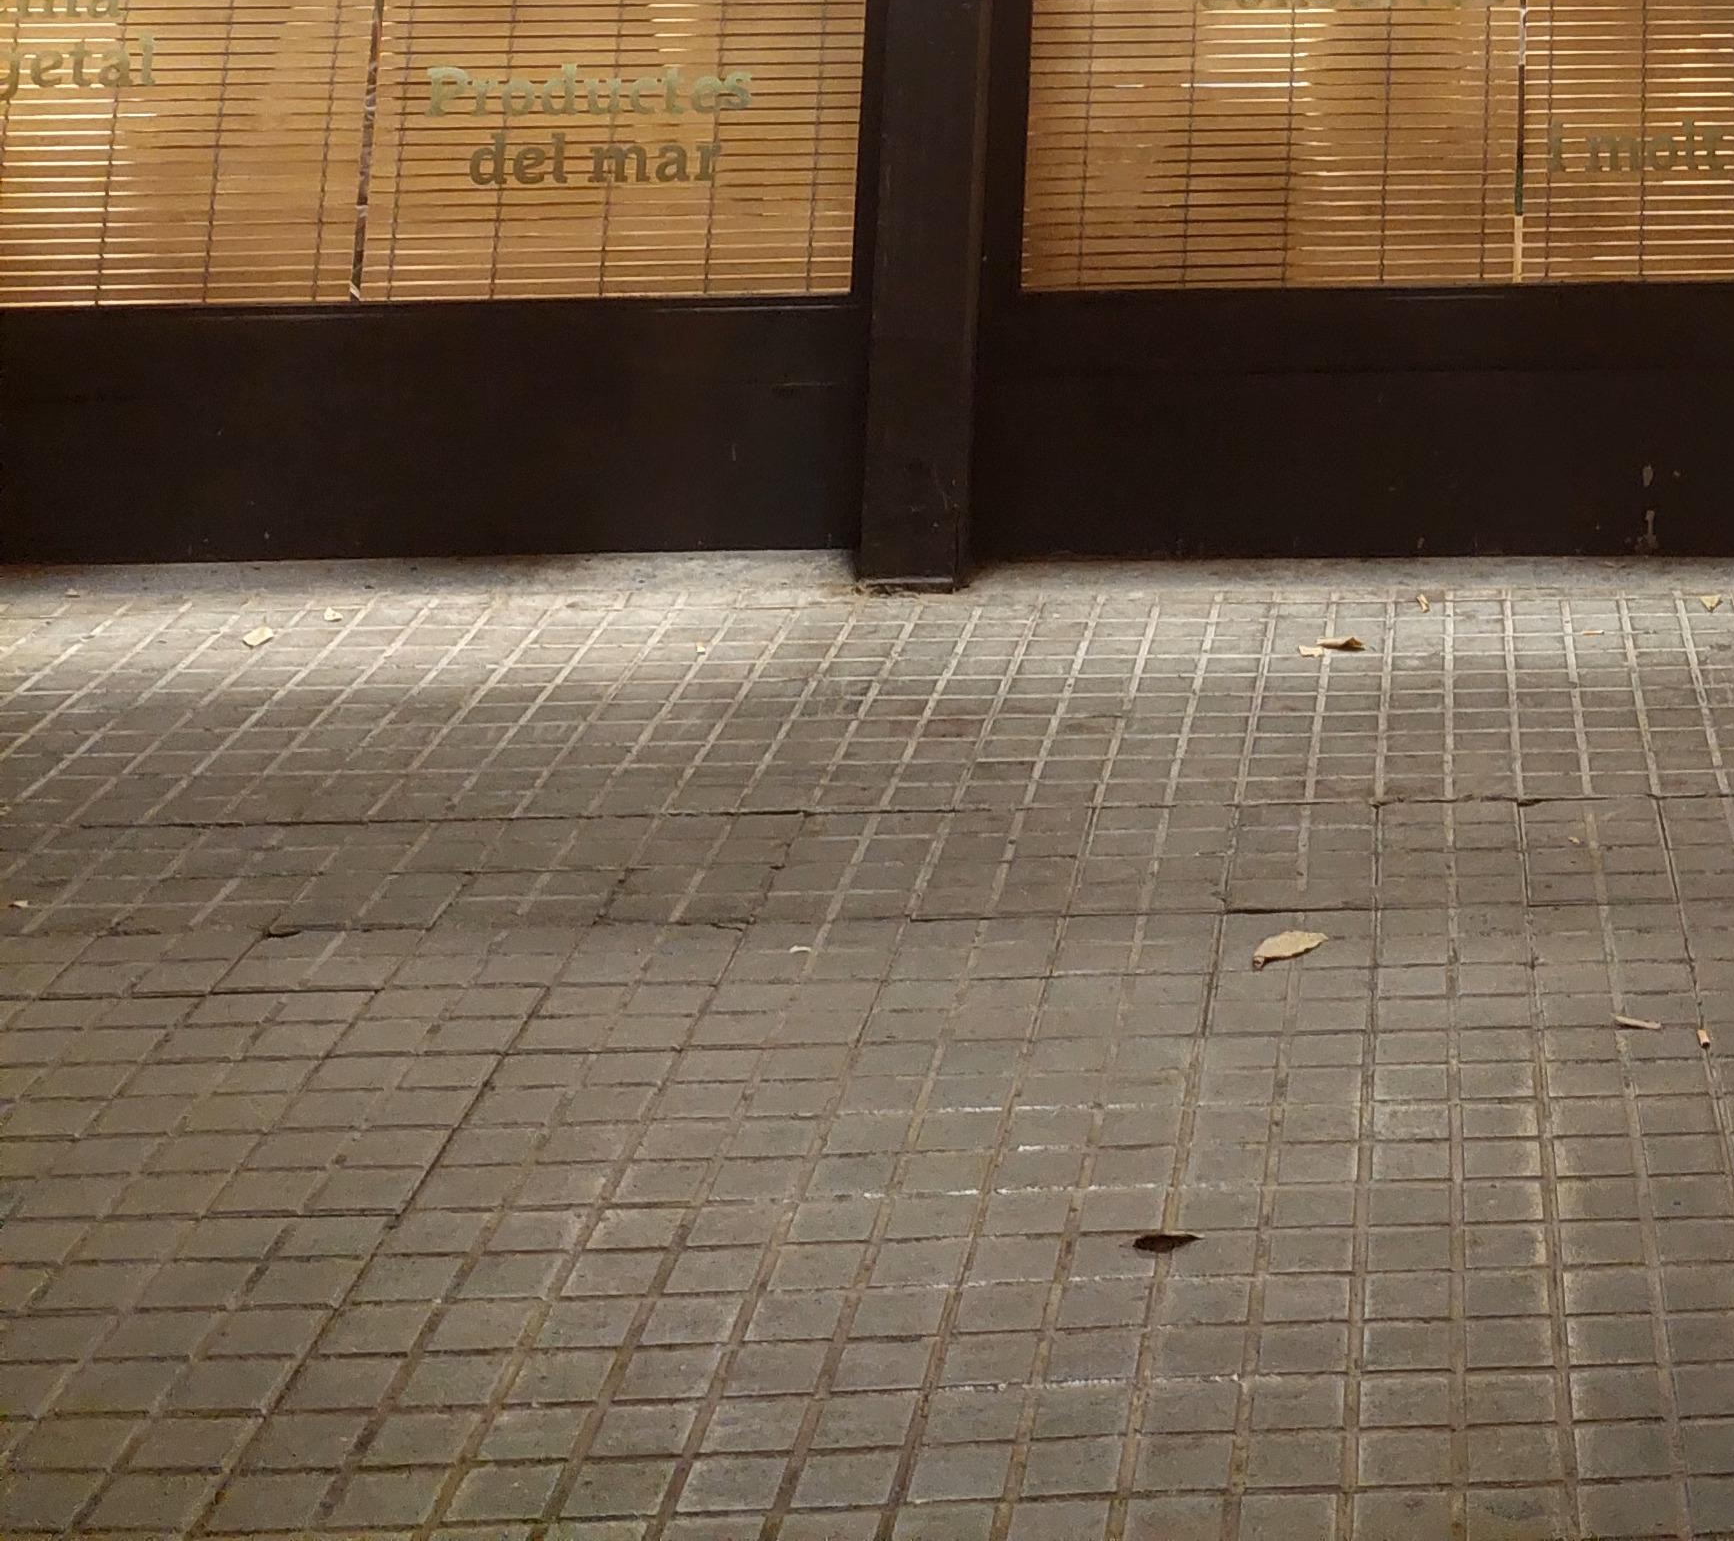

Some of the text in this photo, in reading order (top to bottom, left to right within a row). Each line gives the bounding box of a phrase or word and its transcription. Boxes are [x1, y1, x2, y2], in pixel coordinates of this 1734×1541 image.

[427, 64, 754, 118] Productes
[470, 133, 723, 186] del mar
